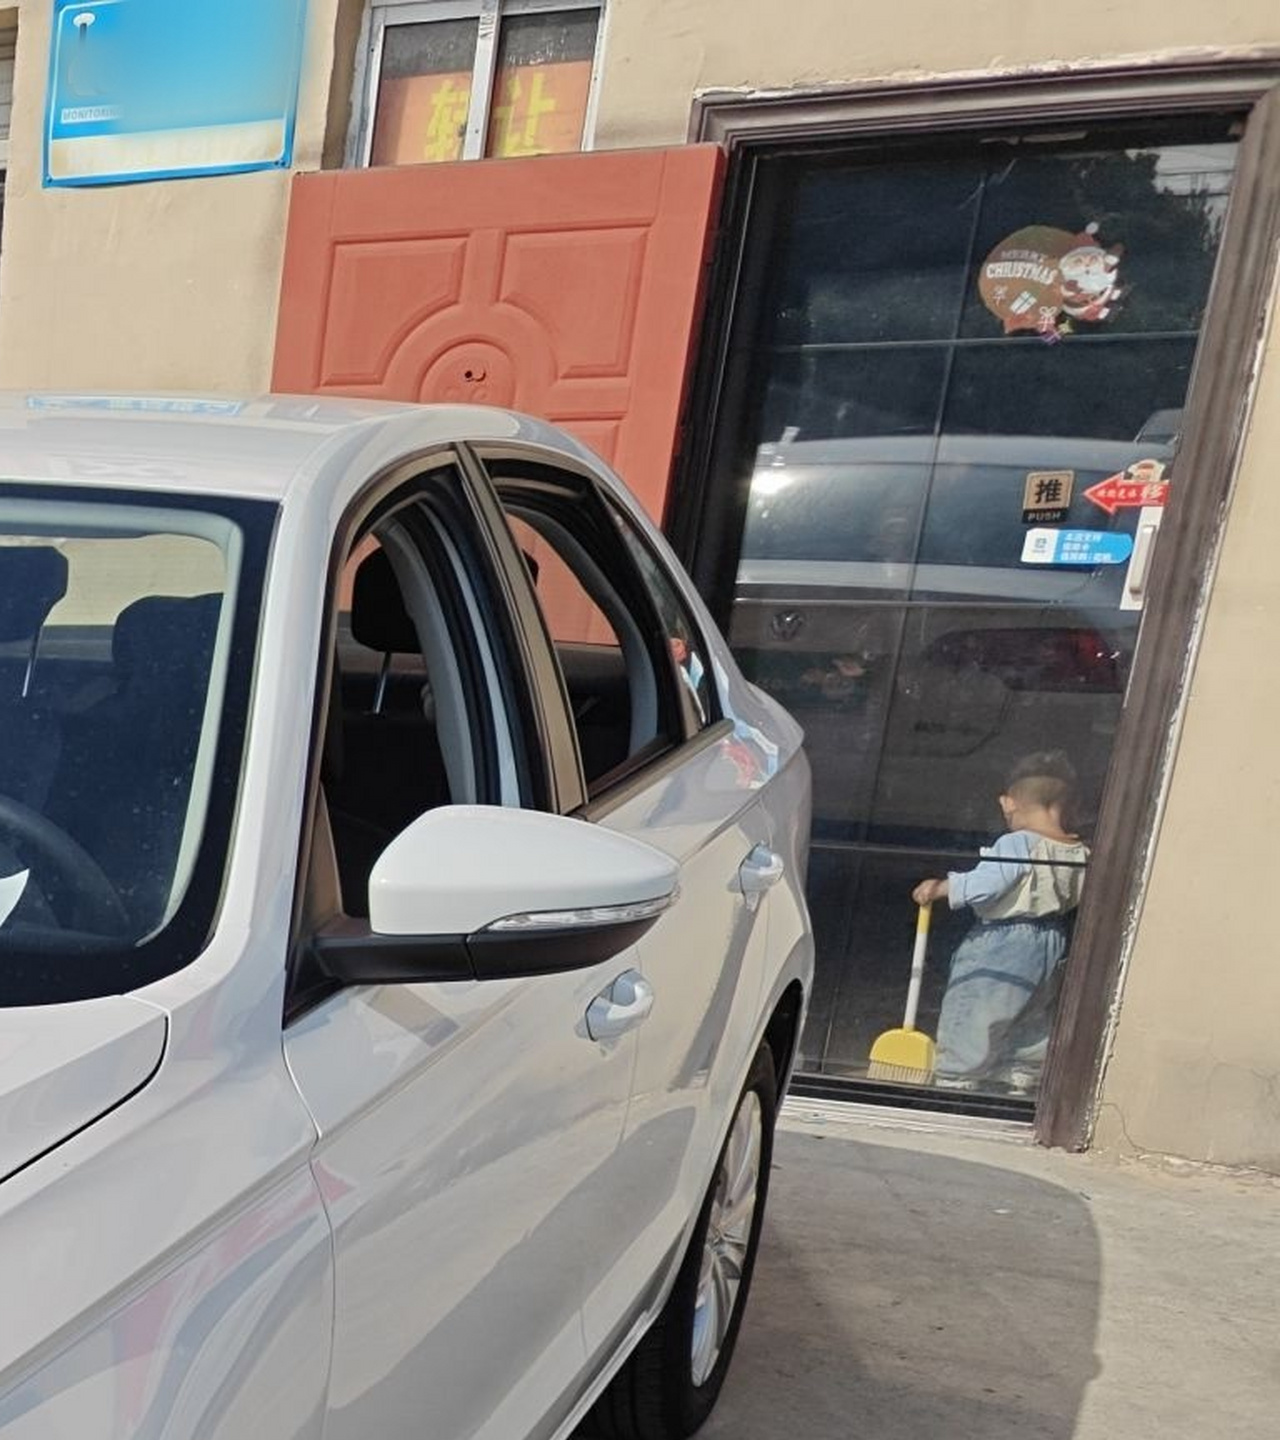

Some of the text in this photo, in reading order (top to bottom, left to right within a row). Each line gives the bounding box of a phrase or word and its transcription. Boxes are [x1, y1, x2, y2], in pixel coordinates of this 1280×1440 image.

[985, 261, 1059, 285] CHRISTMAS
[1034, 478, 1063, 504] 推
[1027, 512, 1061, 521] PUSH
